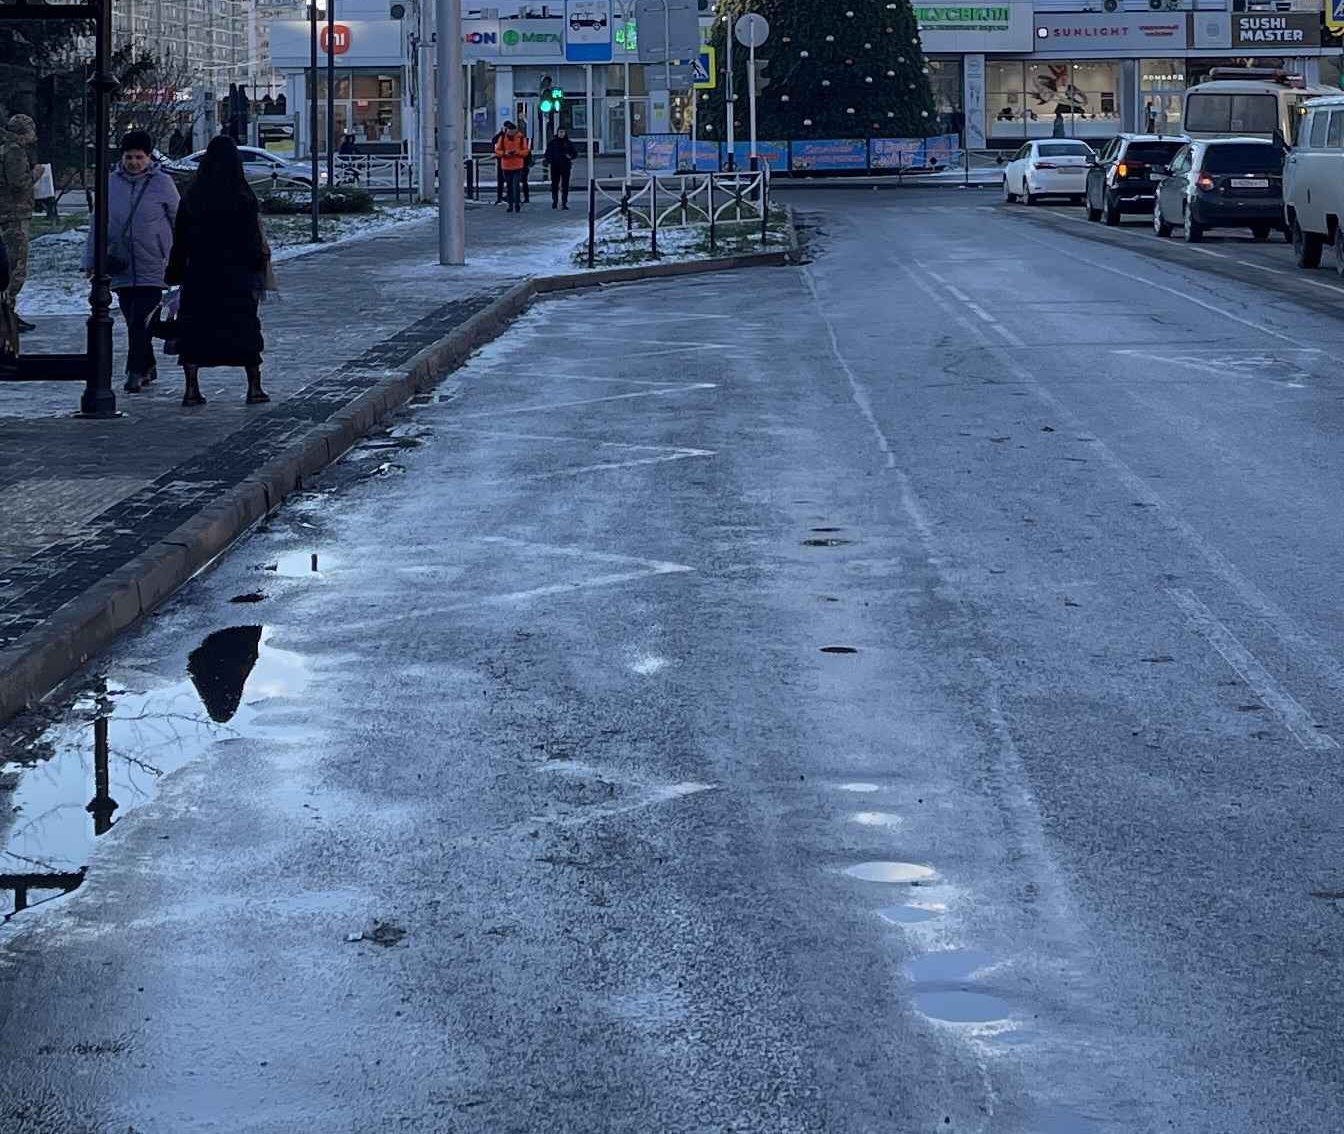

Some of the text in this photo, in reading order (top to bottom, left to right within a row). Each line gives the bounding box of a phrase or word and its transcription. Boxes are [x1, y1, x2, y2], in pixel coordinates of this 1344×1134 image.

[1239, 17, 1287, 30] SUSHI
[1053, 27, 1130, 37] SUNLIGHT
[1239, 29, 1304, 42] MASTER
